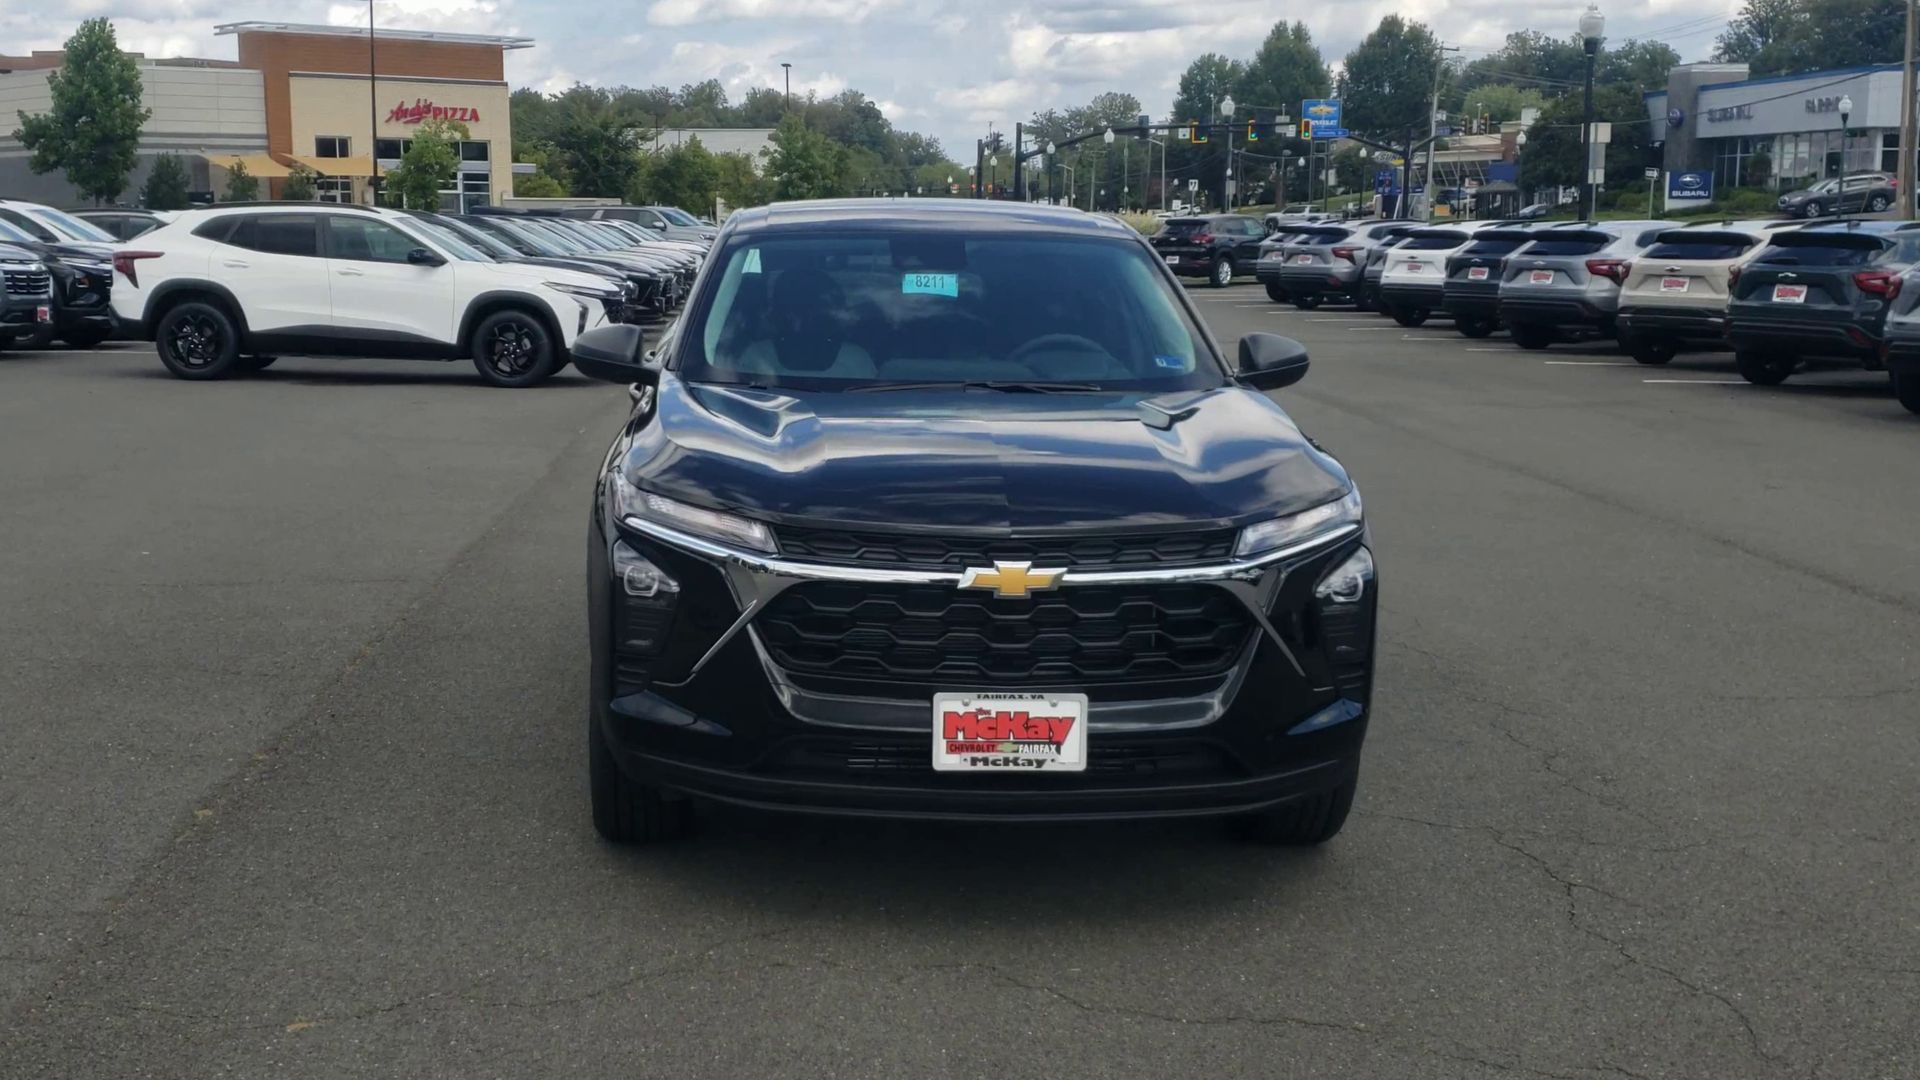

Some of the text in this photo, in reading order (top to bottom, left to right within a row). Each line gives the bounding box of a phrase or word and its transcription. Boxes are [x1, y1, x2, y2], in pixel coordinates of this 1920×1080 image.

[432, 106, 480, 122] PIZZA
[915, 275, 945, 288] 8211
[943, 711, 1076, 746] McKay
[949, 743, 1057, 754] CHEVROLET FAIRFAX
[970, 756, 1048, 768] McKay
